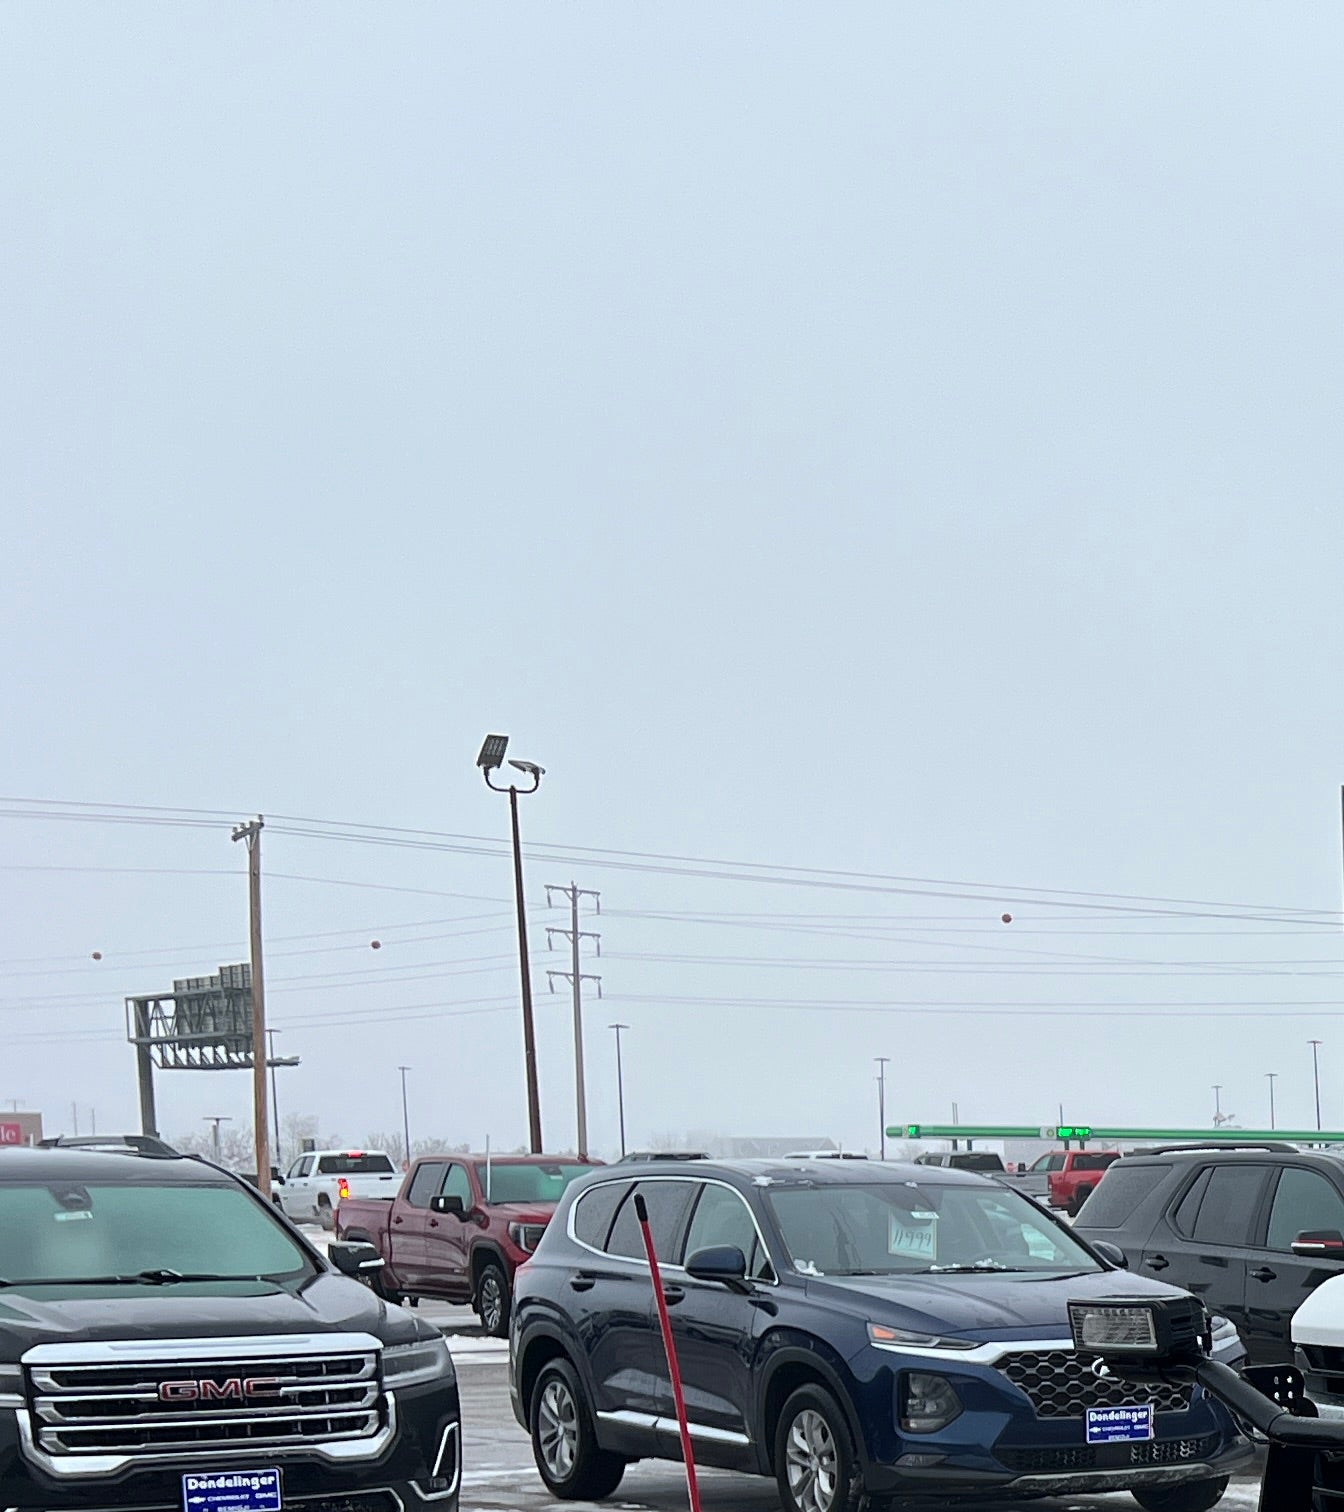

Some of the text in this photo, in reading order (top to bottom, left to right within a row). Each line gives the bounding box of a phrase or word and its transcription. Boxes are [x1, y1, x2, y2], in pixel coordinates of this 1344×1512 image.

[159, 1377, 280, 1402] GMC
[1089, 1410, 1148, 1423] Dondelinger
[187, 1475, 275, 1490] Dondelinger
